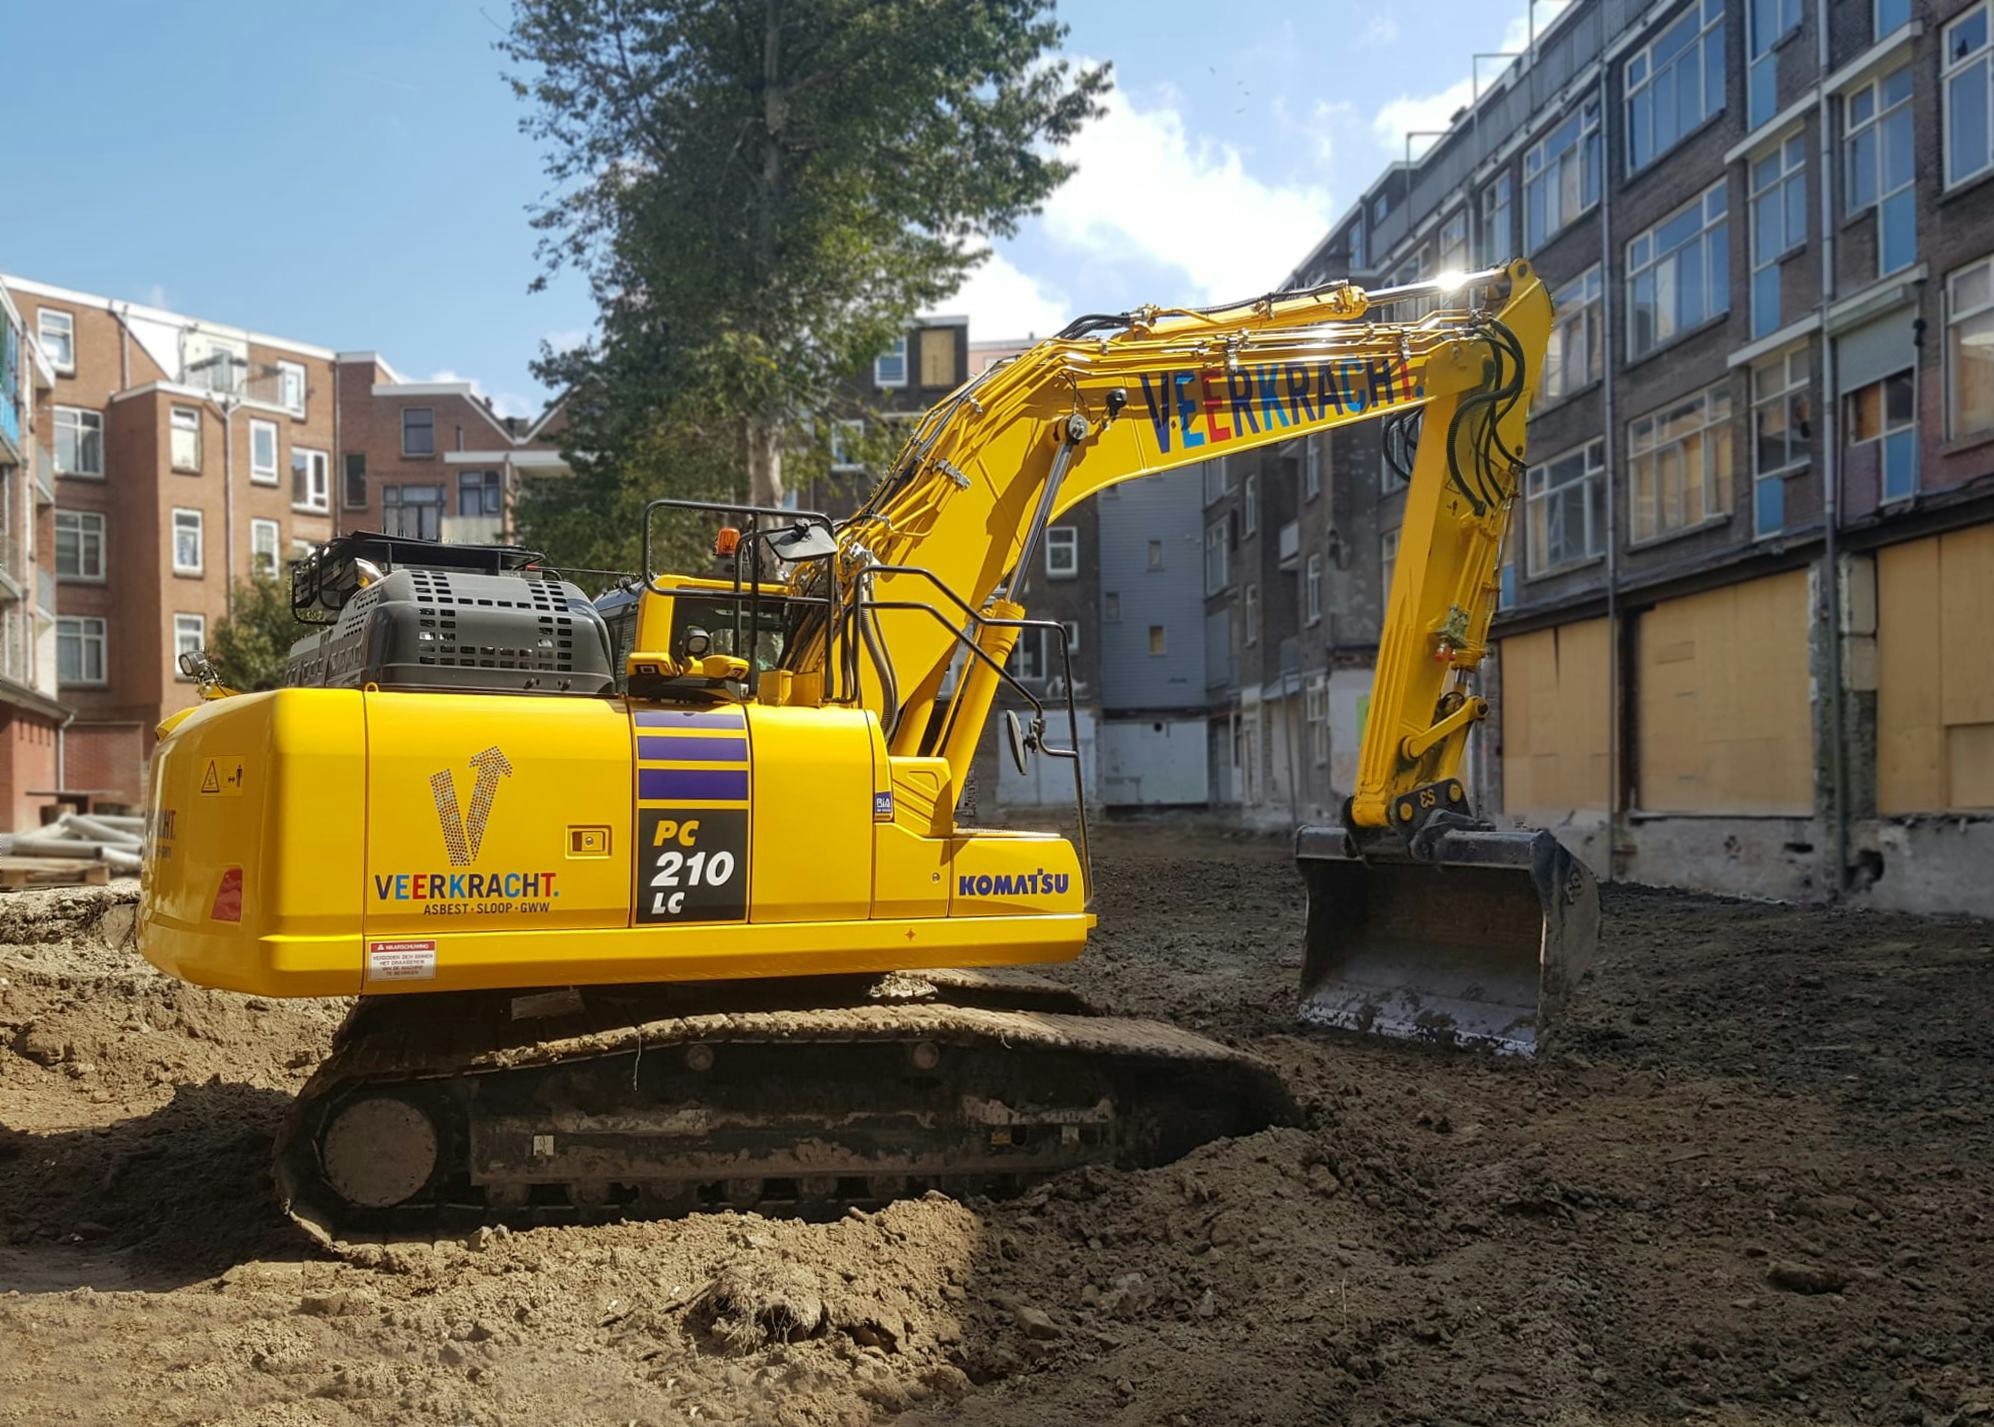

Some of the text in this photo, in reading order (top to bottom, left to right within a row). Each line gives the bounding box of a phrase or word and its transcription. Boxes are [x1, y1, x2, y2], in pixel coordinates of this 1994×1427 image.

[653, 820, 700, 847] PC
[650, 851, 735, 887] 210
[959, 868, 1069, 896] KOMATSU
[374, 873, 559, 900] VEERKRACHT.
[423, 902, 550, 916] ASBEST SLOOP GWW
[651, 892, 686, 914] LC
